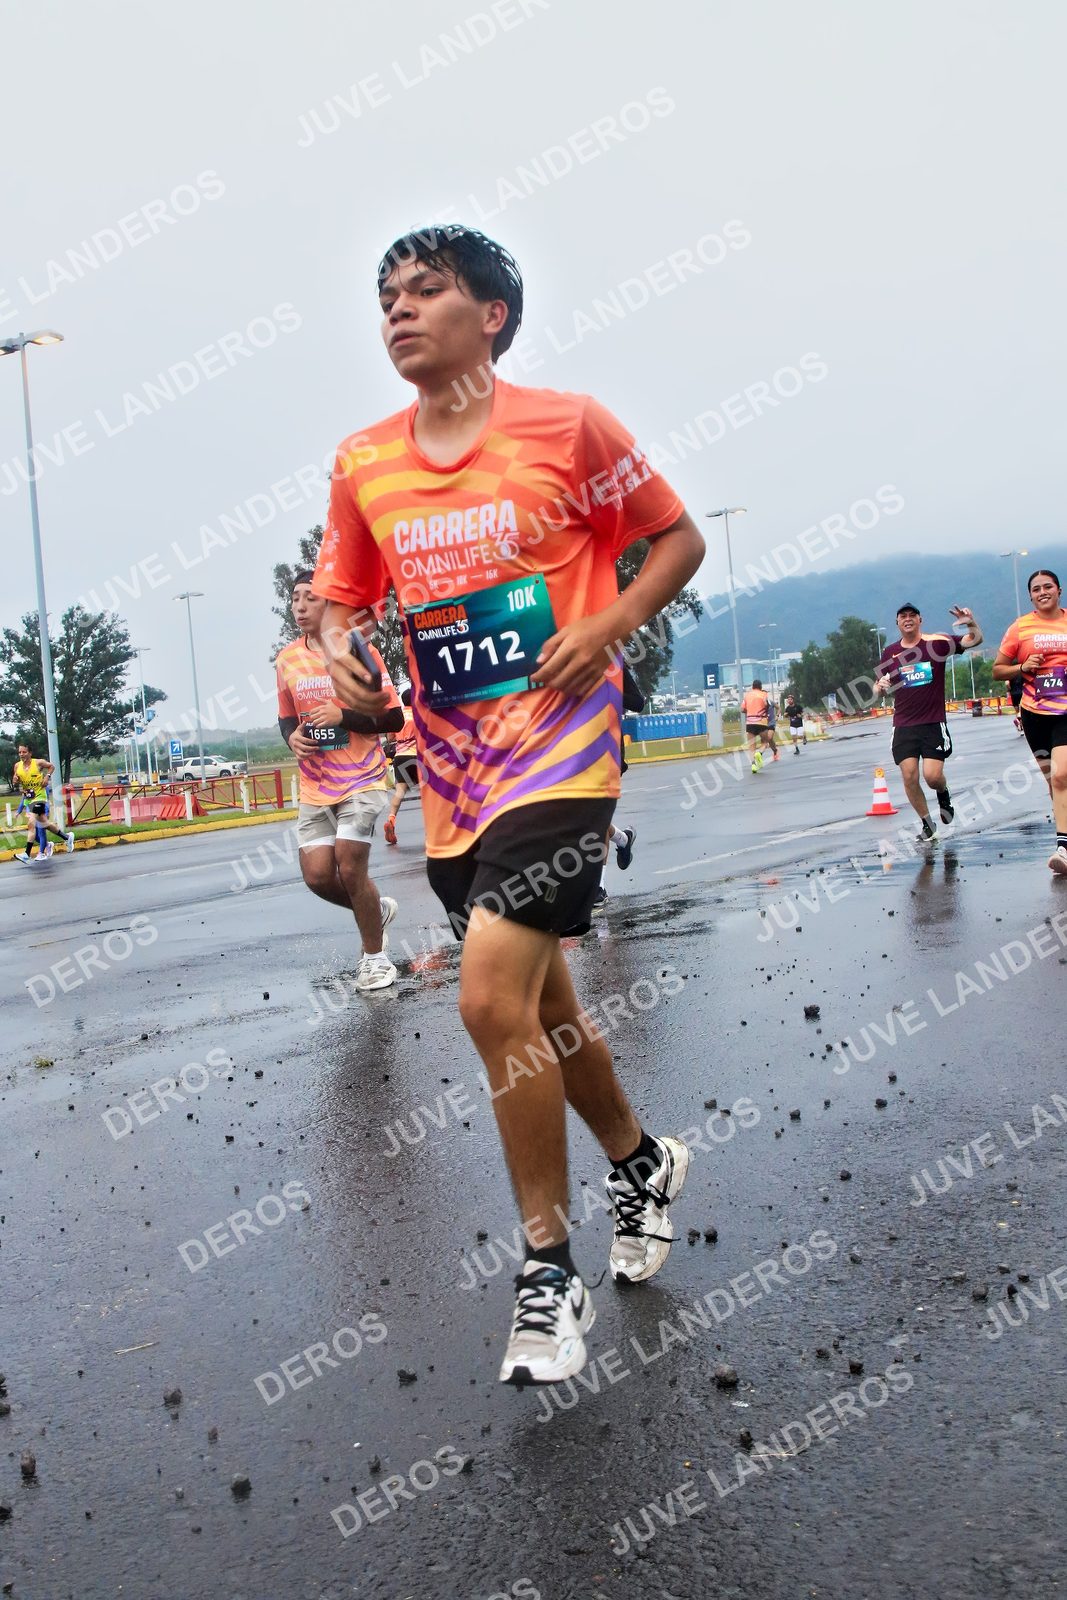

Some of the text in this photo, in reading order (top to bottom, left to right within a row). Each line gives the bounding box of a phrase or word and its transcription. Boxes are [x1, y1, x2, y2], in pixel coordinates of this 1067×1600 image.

[394, 500, 518, 555] CARRERA
[507, 585, 537, 612] 10K
[413, 604, 468, 630] CARRERA
[437, 630, 526, 675] 1712
[707, 674, 715, 686] E
[1043, 678, 1064, 688] 474
[309, 728, 336, 740] 1655
